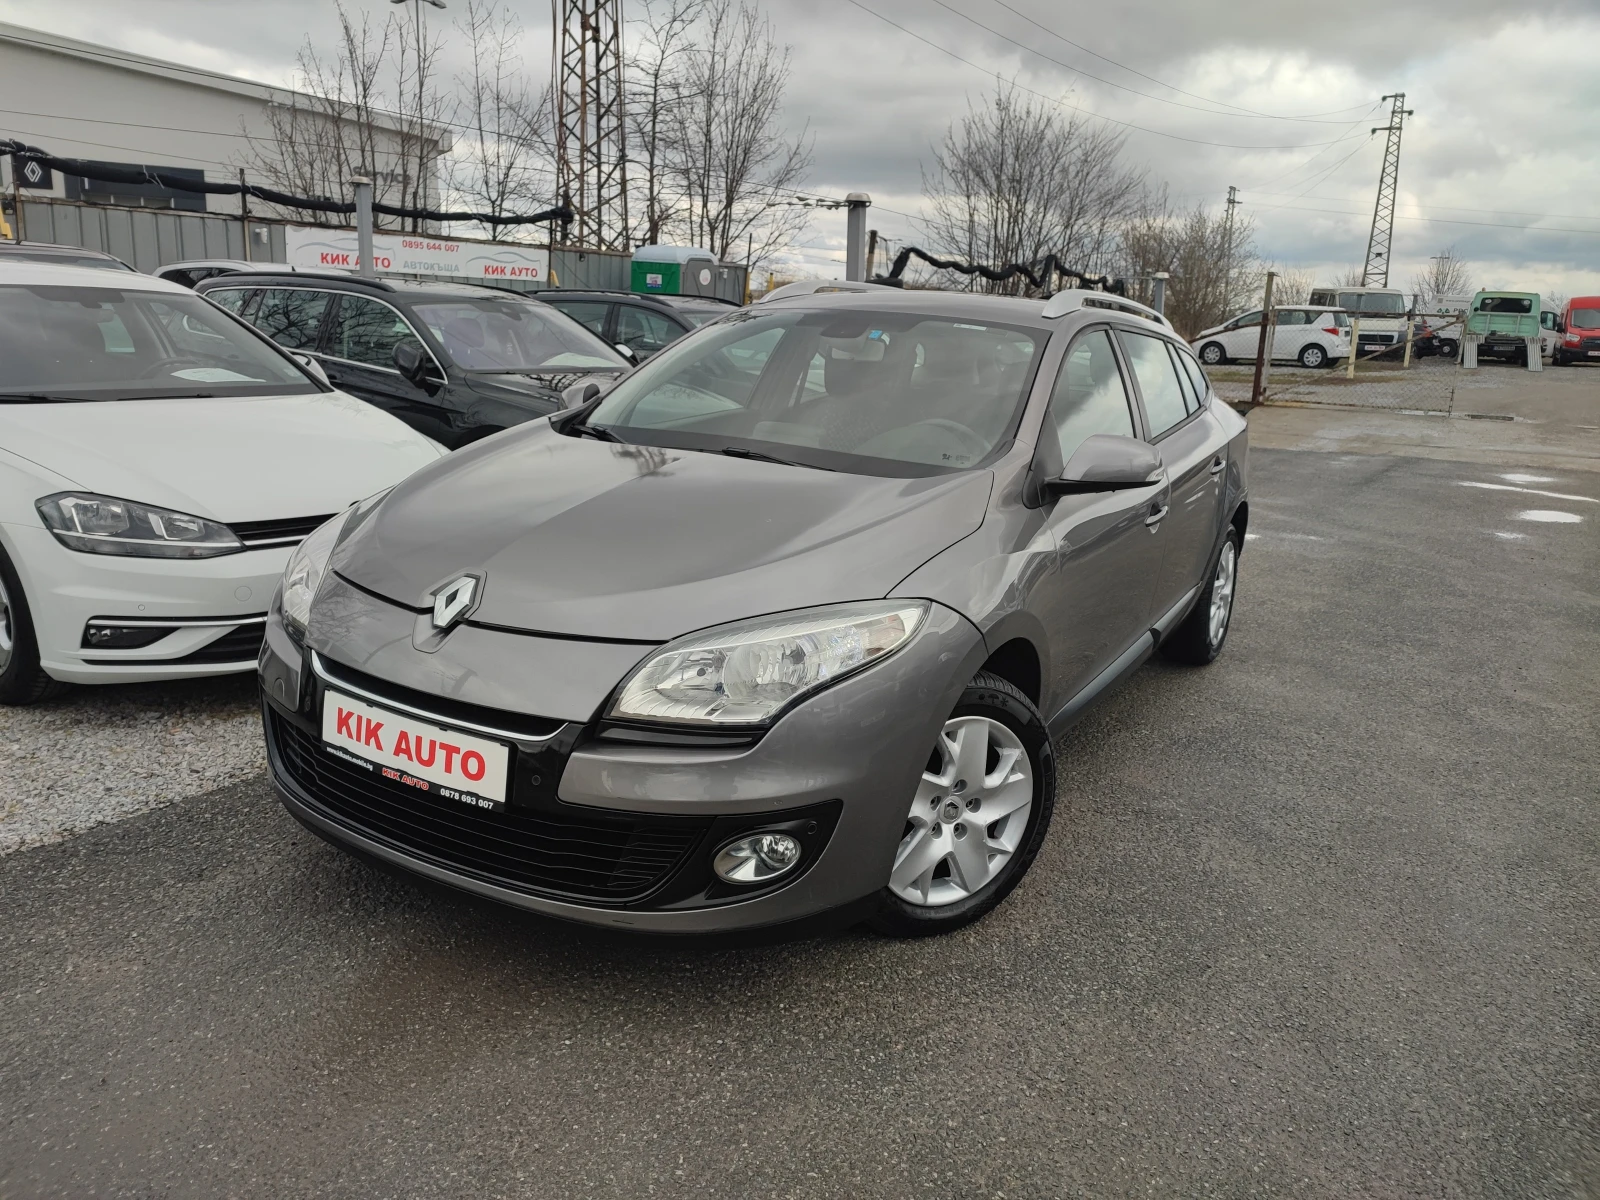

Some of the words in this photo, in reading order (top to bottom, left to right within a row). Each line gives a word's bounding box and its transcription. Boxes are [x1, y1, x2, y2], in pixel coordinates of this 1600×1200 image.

[402, 240, 424, 249] 0895
[426, 242, 442, 251] 644
[445, 244, 460, 252] 007
[320, 252, 350, 266] КИК
[354, 255, 391, 269] ТО
[403, 260, 460, 273] АВТОКЪЩА
[484, 264, 506, 276] КИК
[510, 266, 538, 278] АУТО
[337, 707, 384, 752] KIK
[393, 730, 486, 782] AUTO
[382, 767, 400, 780] KIK
[401, 774, 429, 791] AUTO
[440, 788, 460, 800] 0878
[461, 794, 477, 805] 693
[478, 799, 494, 810] 007
